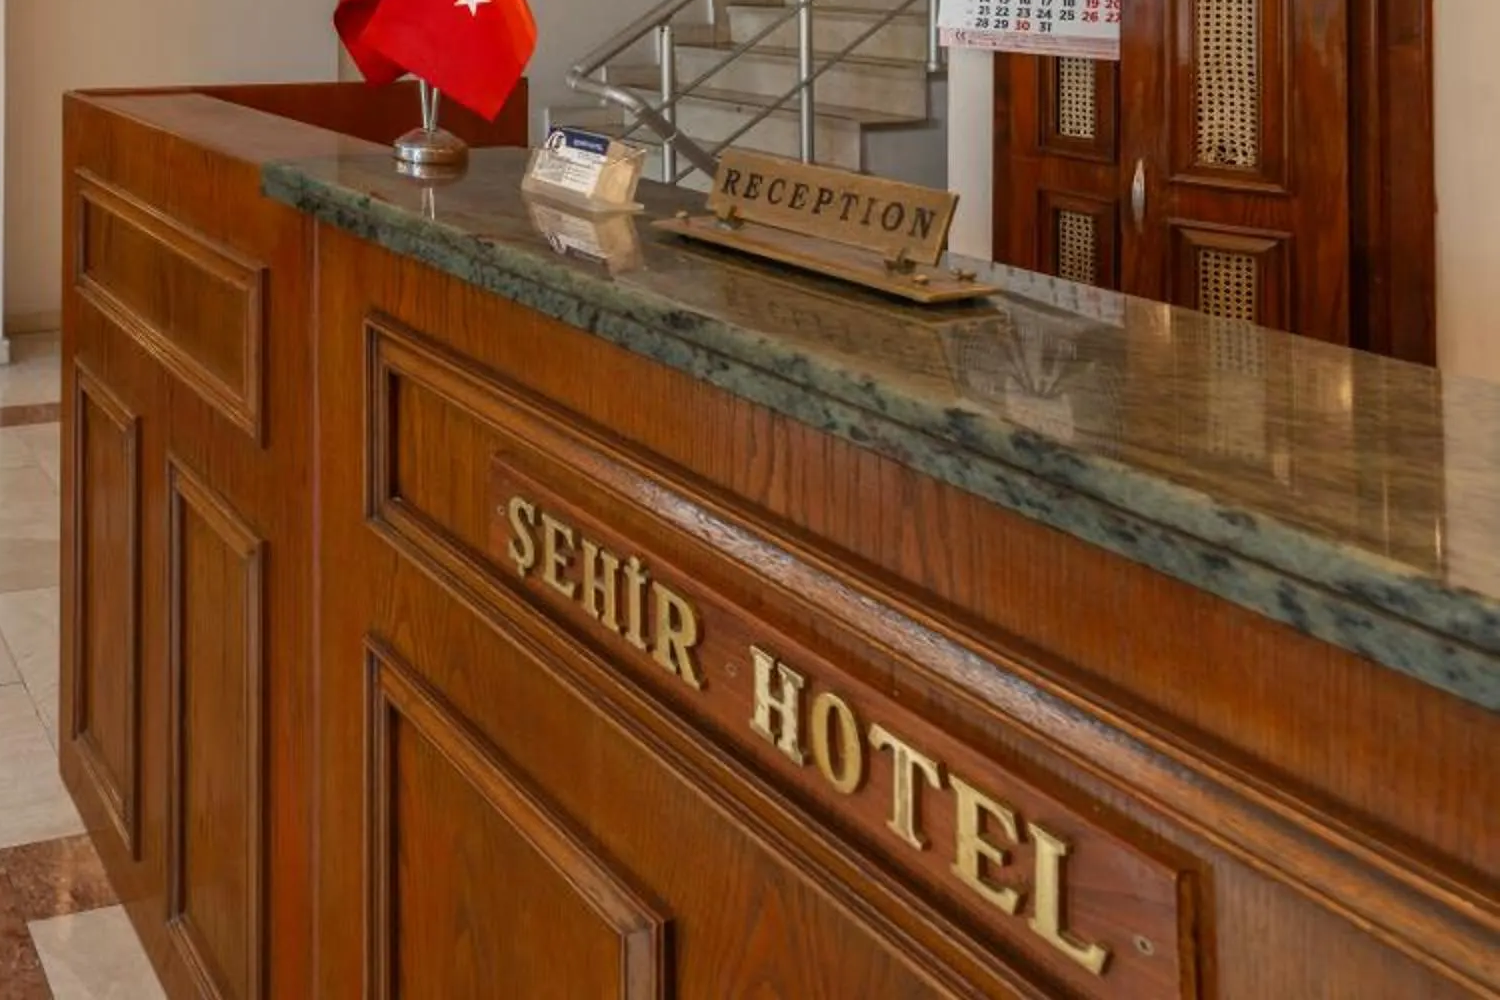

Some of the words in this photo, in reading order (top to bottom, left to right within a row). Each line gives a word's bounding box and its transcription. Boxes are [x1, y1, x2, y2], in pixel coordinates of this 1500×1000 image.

[975, 18, 989, 28] 28
[994, 19, 1008, 28] 29
[1014, 21, 1030, 30] 30
[1039, 21, 1051, 32] 31
[979, 6, 990, 15] 21
[995, 7, 1009, 16] 22
[1017, 8, 1030, 17] 23
[1036, 9, 1052, 18] 24
[1060, 10, 1075, 20] 25
[1082, 11, 1098, 21] 26
[721, 168, 936, 239] RECEPTION
[508, 496, 701, 690] ŞEHİR
[749, 645, 1108, 976] HOTEL
